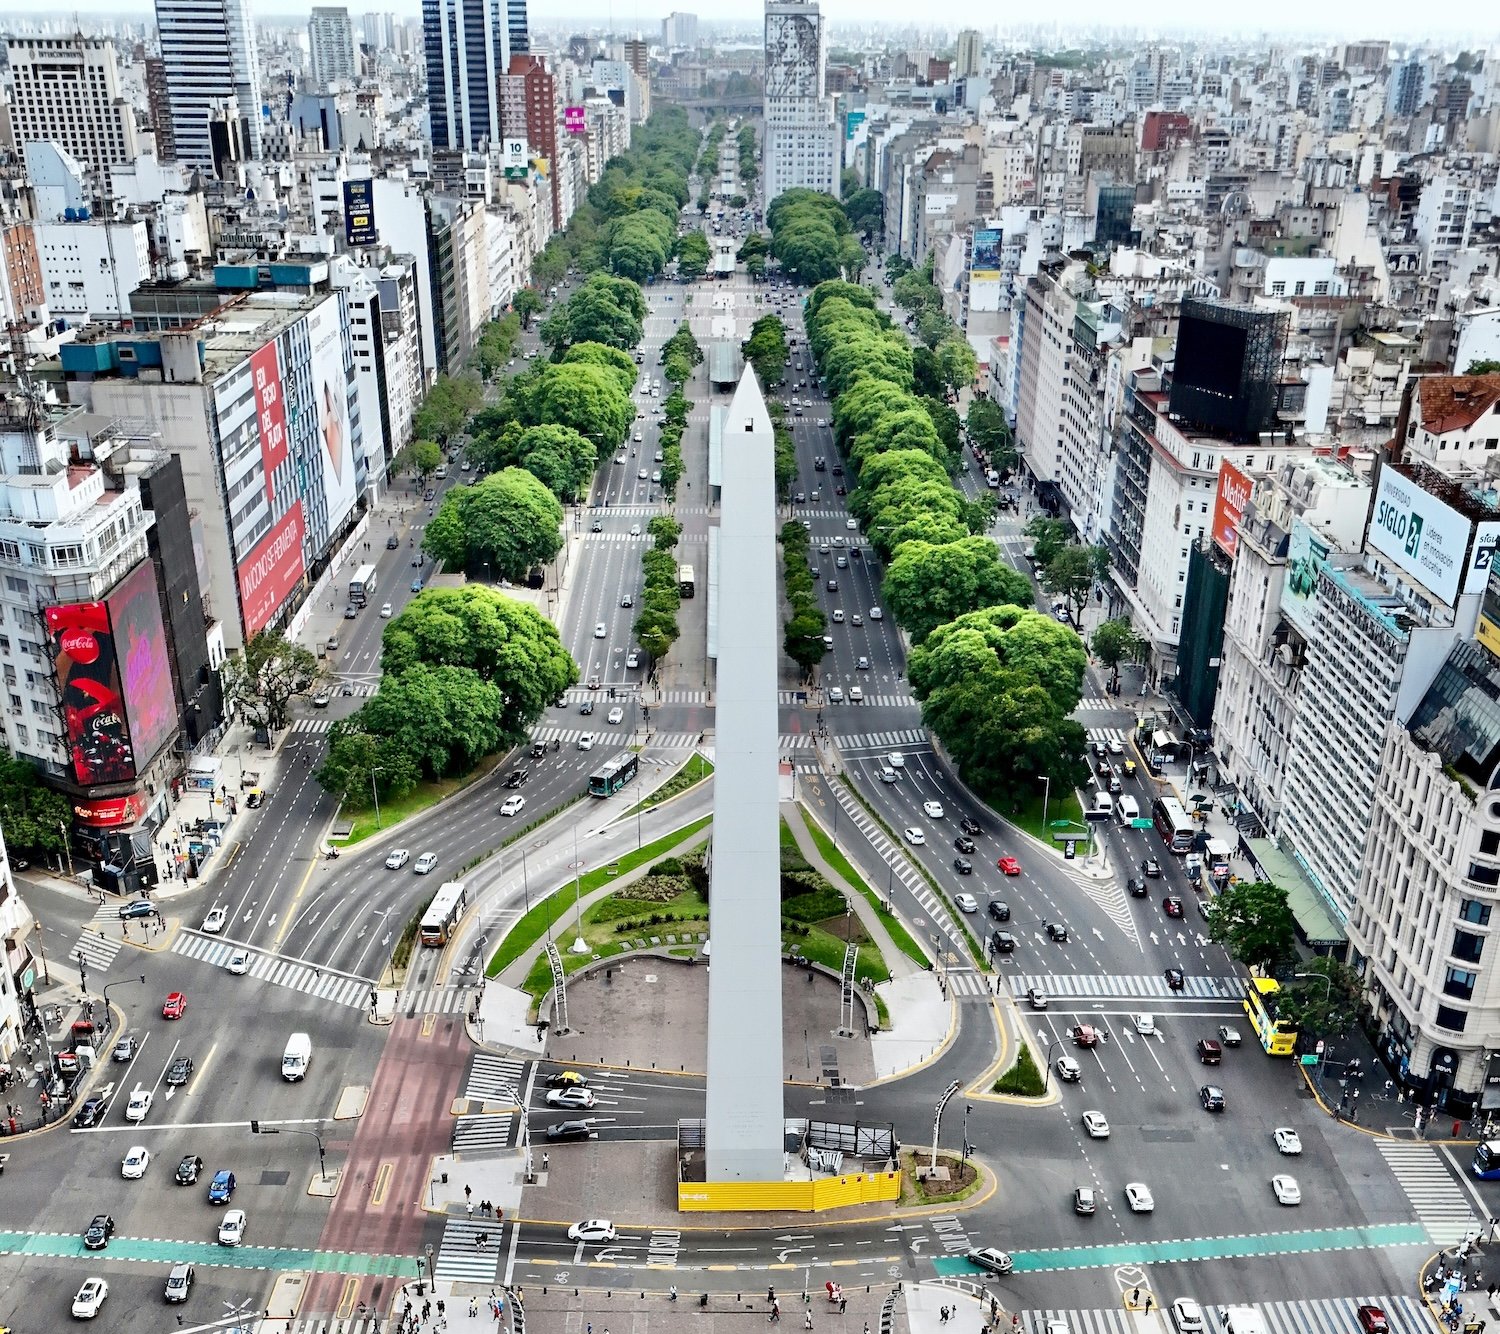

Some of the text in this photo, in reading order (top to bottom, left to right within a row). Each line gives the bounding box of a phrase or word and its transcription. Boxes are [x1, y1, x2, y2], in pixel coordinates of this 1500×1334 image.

[509, 143, 522, 153] 10
[256, 366, 266, 390] EDI
[262, 382, 277, 409] FICIO
[261, 409, 273, 434] DEL
[267, 423, 283, 452] PLATA
[1221, 473, 1247, 513] Medifé
[1383, 480, 1411, 507] UNIVERSIDAD
[1377, 500, 1419, 559] SIGLO 21
[1426, 524, 1443, 545] Líderes
[266, 543, 275, 572] SE
[1430, 543, 1454, 570] innovación
[1476, 549, 1493, 570] 21
[62, 637, 94, 652] Coca-Cola
